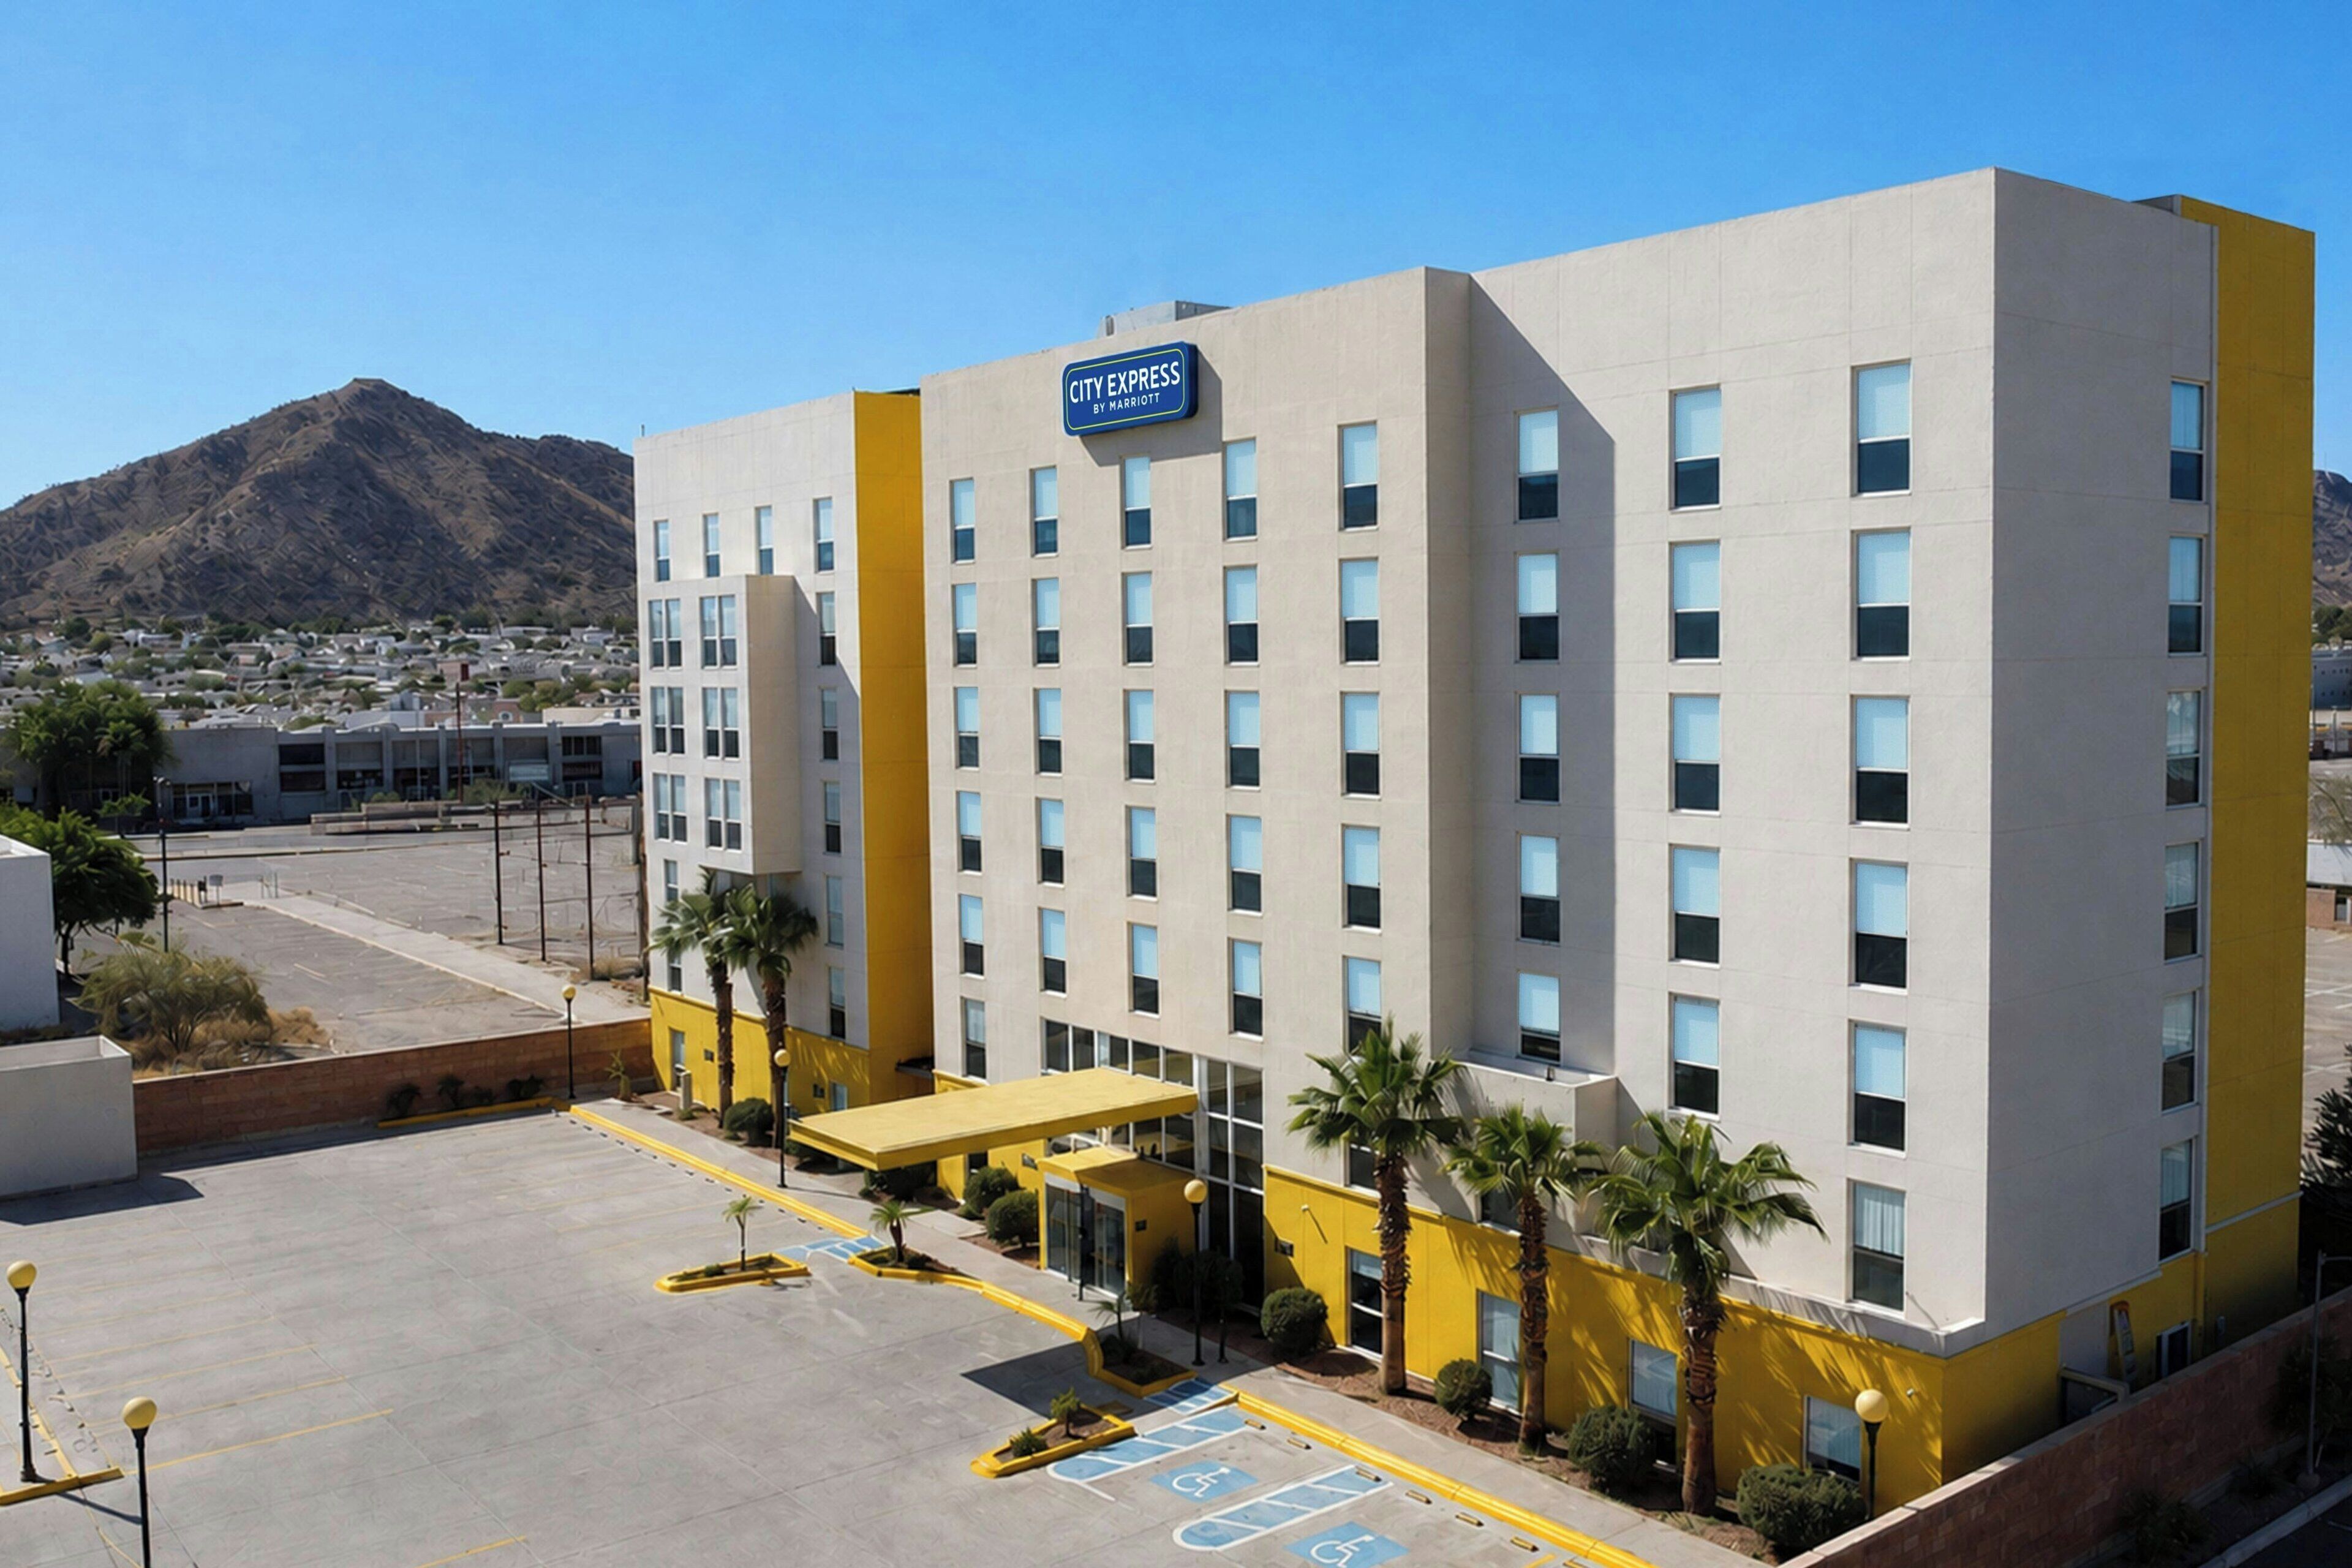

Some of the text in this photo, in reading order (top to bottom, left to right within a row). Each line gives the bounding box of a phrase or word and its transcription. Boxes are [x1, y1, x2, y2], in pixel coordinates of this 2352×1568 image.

[1070, 361, 1180, 403] CITY EXPRESS
[1093, 393, 1159, 414] BY MARRIOTT
